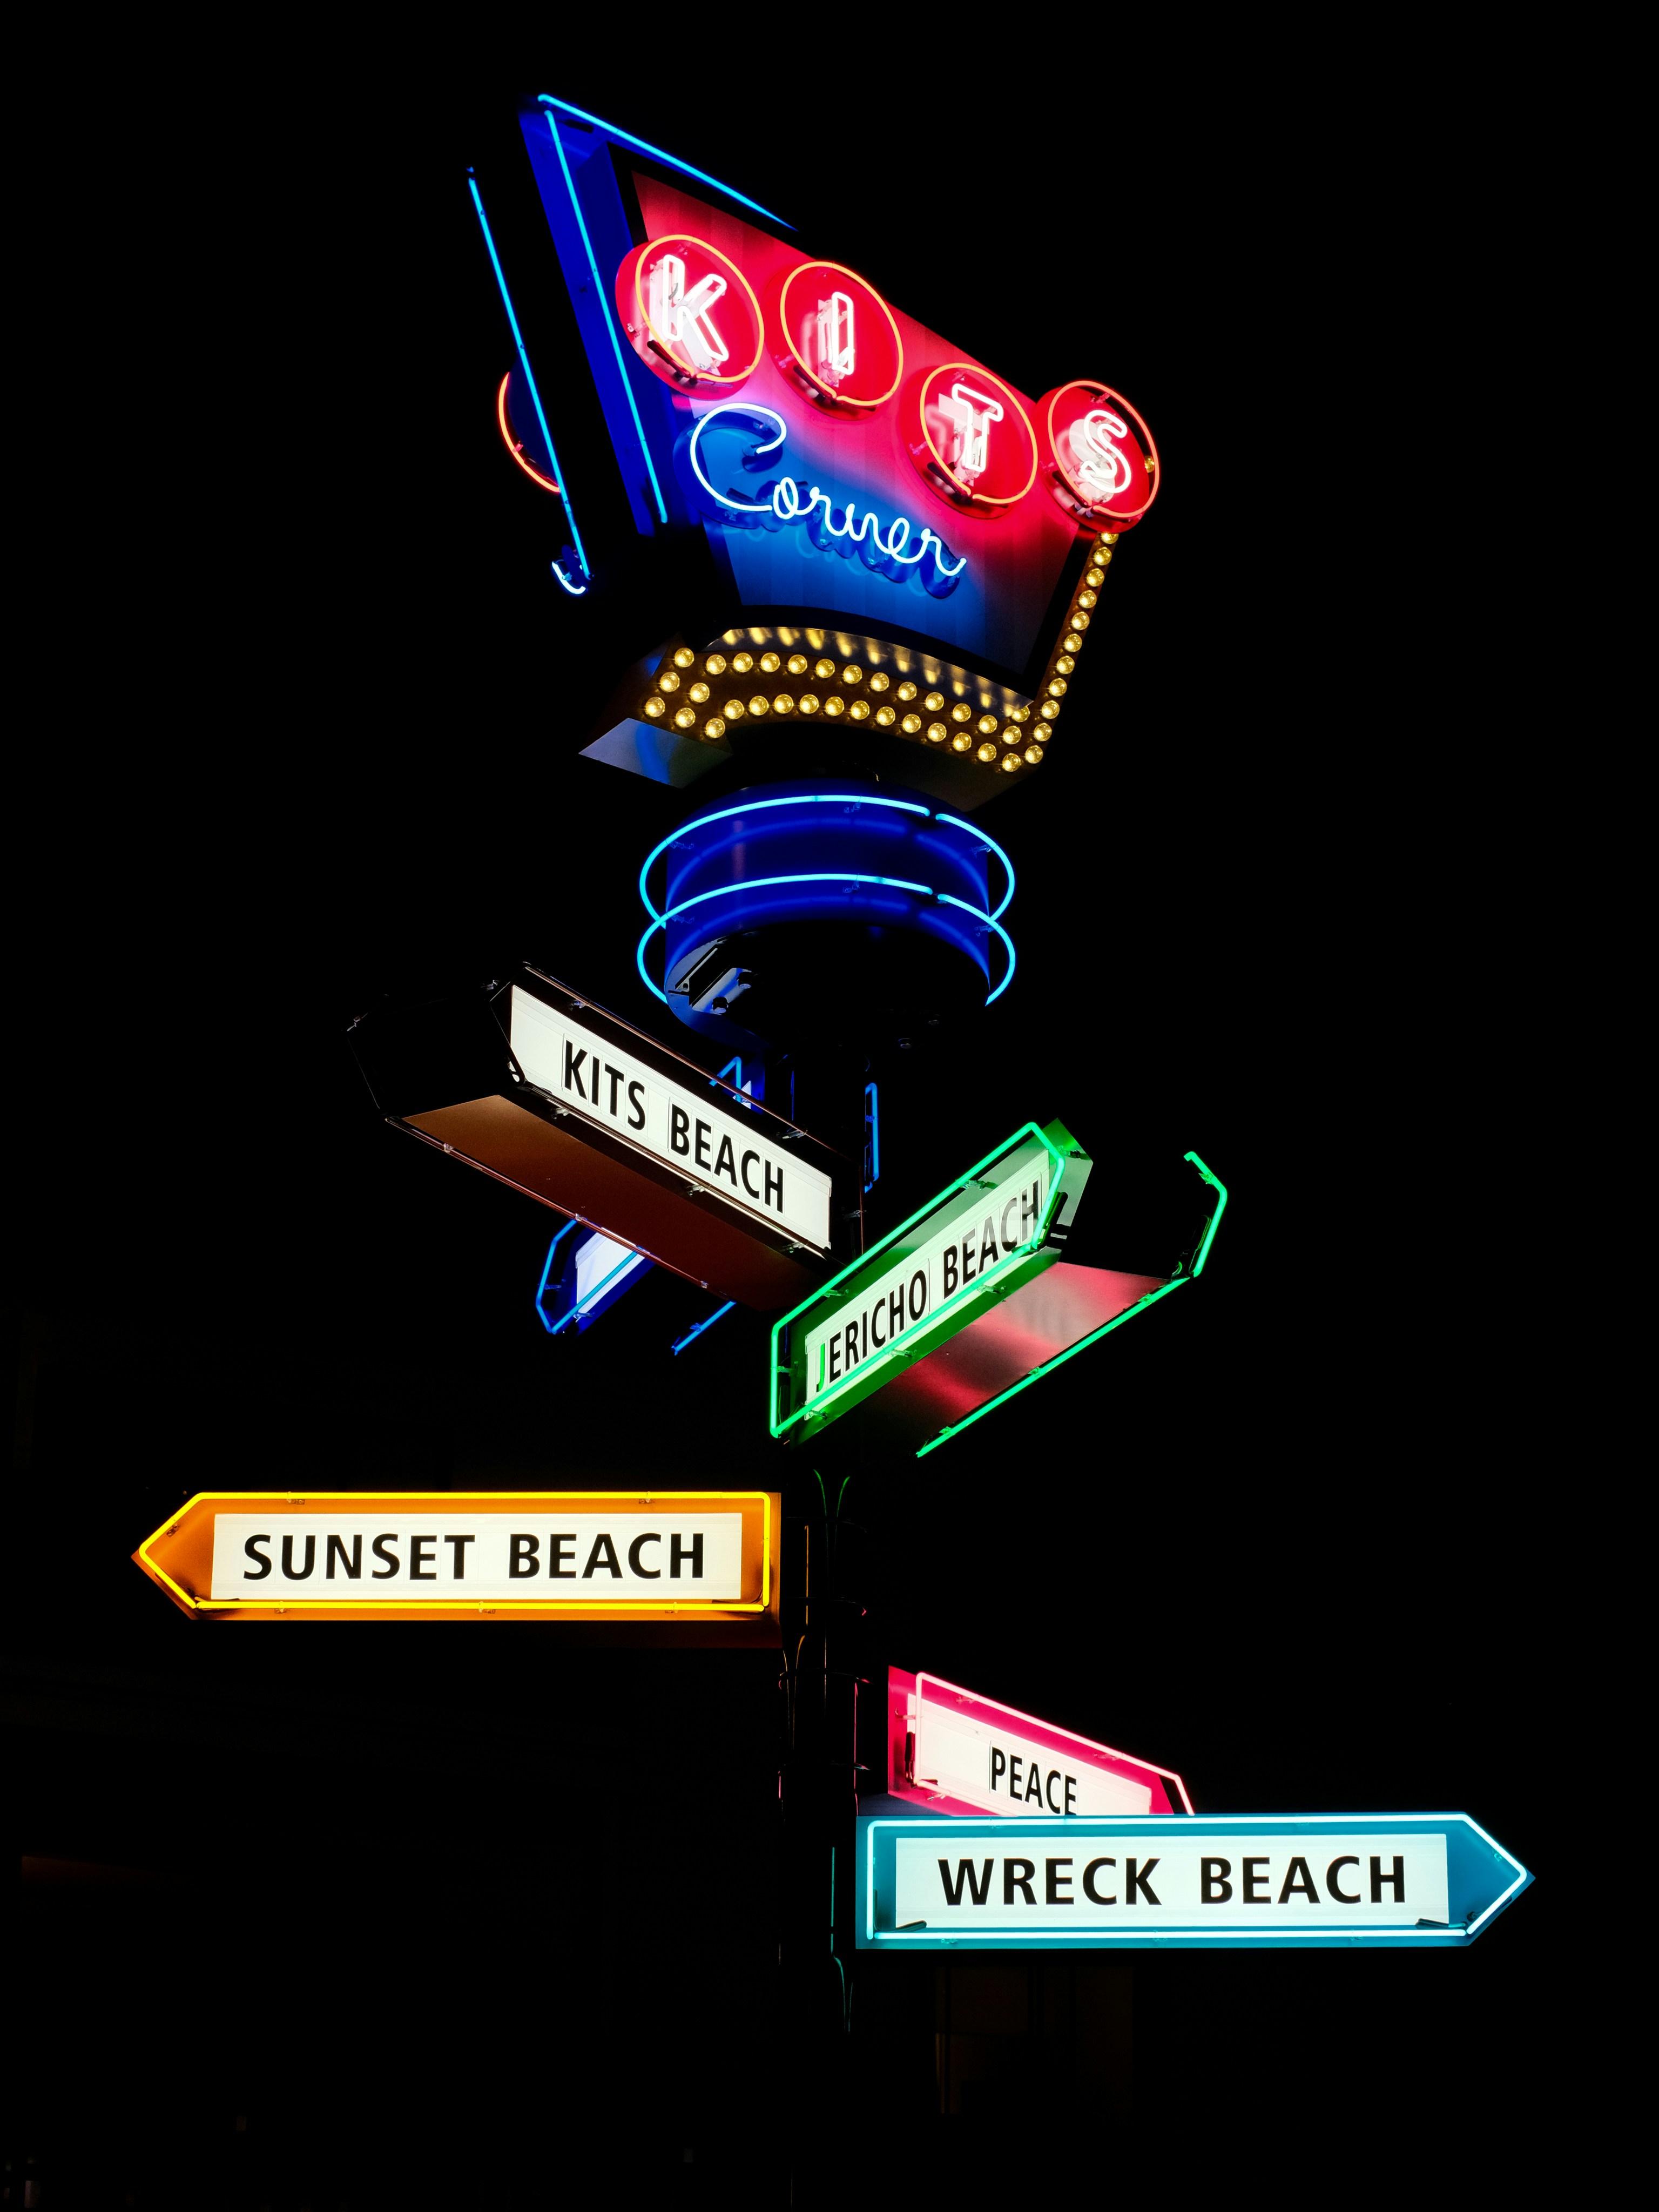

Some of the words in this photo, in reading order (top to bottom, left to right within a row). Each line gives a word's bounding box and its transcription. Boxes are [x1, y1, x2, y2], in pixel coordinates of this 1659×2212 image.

[661, 254, 1132, 494] KITS
[690, 402, 967, 577] Corner
[564, 1039, 646, 1130] KITS
[670, 1103, 784, 1214] BEACH
[816, 1269, 928, 1393] JERICHO
[943, 1178, 1040, 1300] BEACH
[242, 1533, 475, 1581] SUNSET
[508, 1533, 705, 1580] BEACH
[991, 1746, 1077, 1815] PEACE
[938, 1857, 1162, 1905] WRECK
[1200, 1855, 1405, 1904] BEACH
